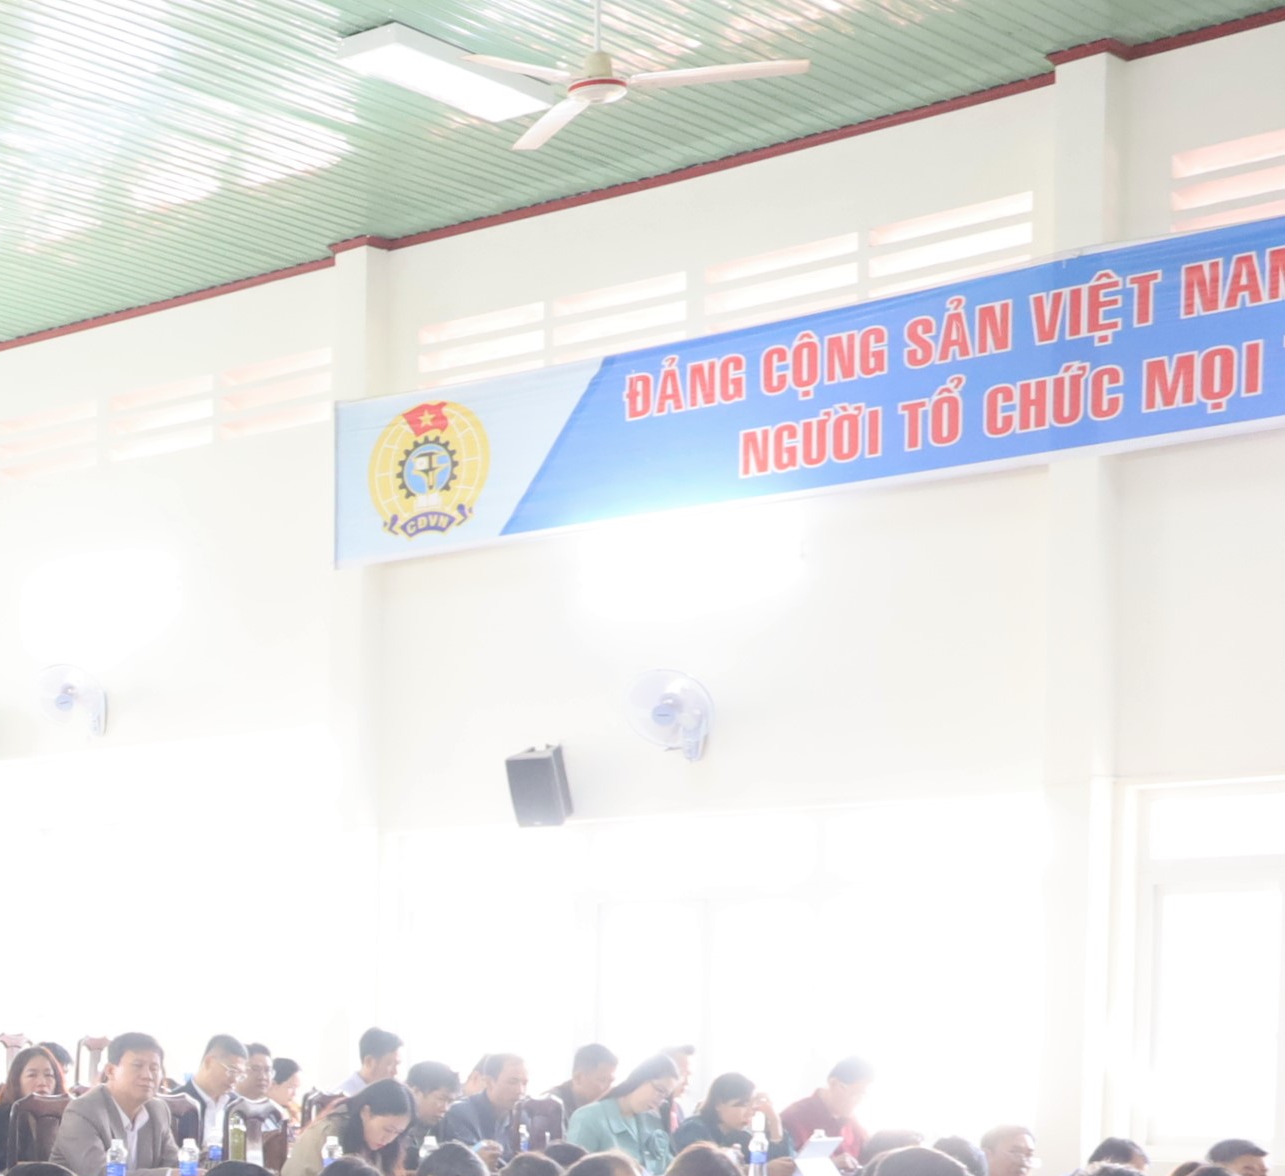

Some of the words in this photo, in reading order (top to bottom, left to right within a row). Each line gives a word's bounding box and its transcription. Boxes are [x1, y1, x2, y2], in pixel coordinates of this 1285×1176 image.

[623, 356, 746, 421] ĐẢNG
[761, 327, 888, 400] CỘNG
[904, 295, 1013, 369] SẢN
[1030, 269, 1162, 347] VIỆT
[739, 402, 883, 478] NGƯỜI
[899, 374, 966, 451] TỔ
[983, 361, 1124, 437] CHỨC
[1142, 339, 1264, 413] MỌI
